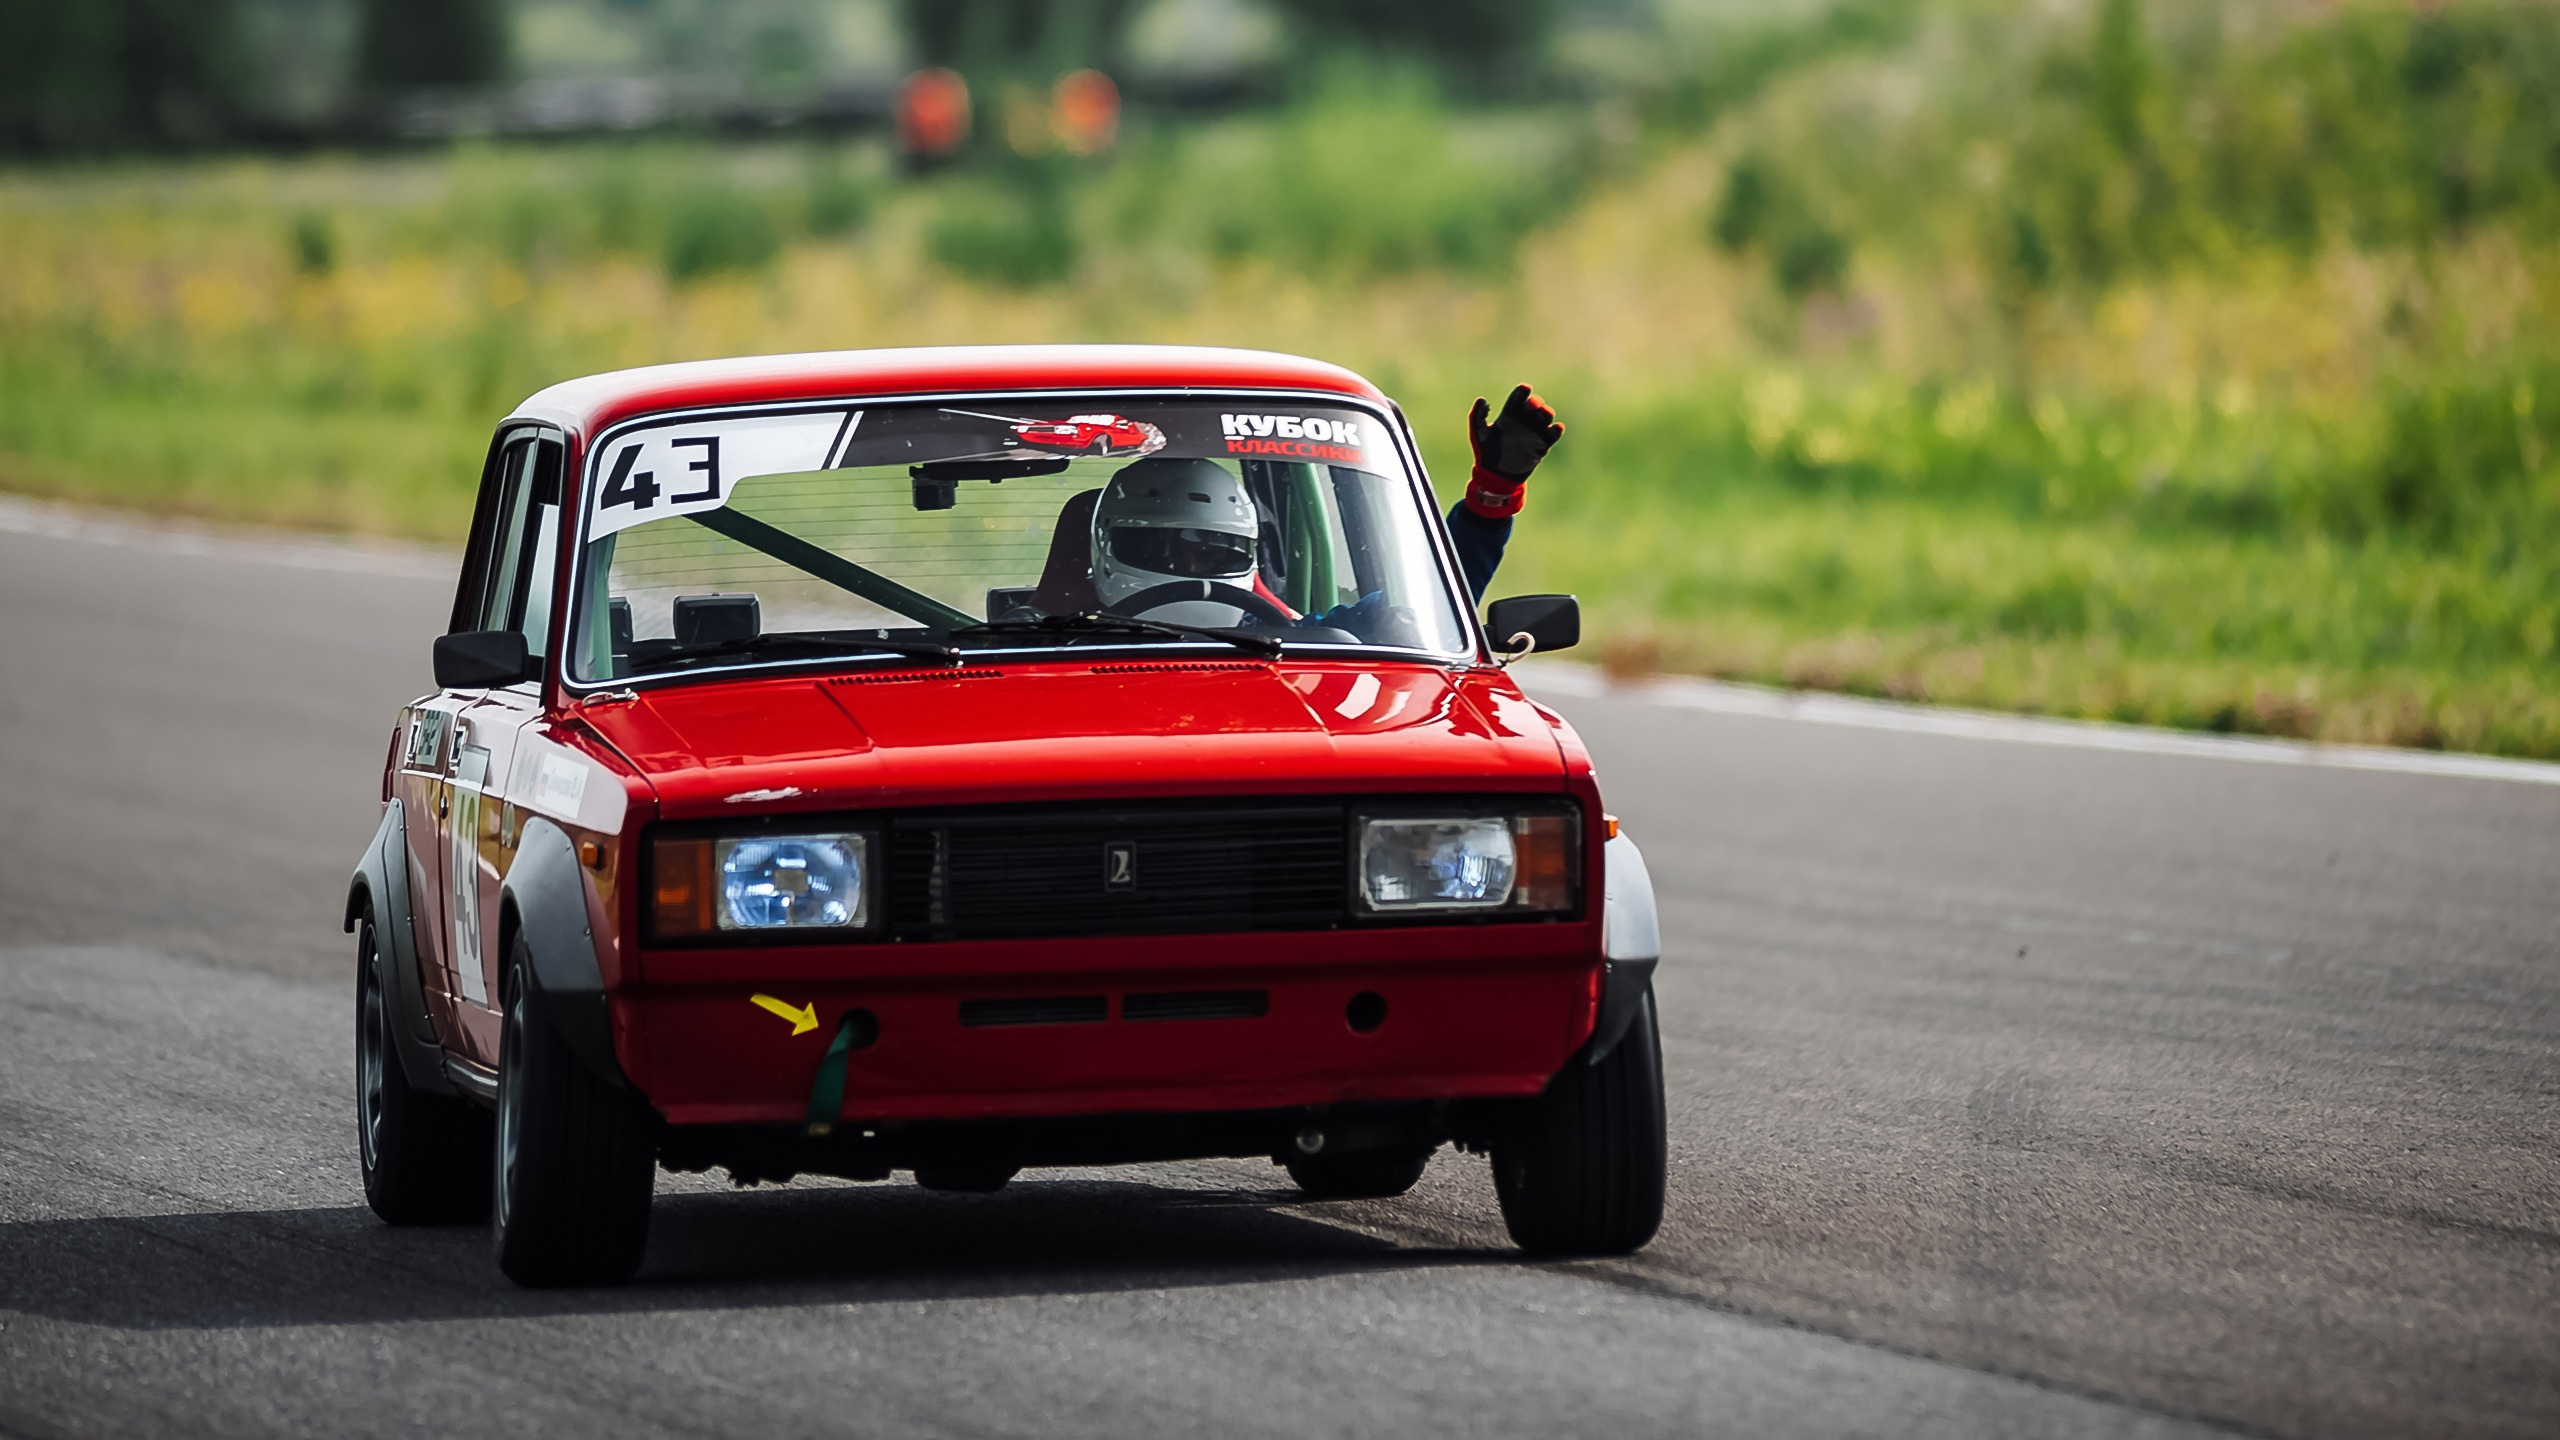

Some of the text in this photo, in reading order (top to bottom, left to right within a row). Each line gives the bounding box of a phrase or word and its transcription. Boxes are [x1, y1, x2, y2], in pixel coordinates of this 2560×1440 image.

[1221, 413, 1361, 446] КУБОК
[1226, 440, 1362, 463] КЛАССИКИ
[600, 436, 721, 511] 43
[455, 794, 478, 960] 43
